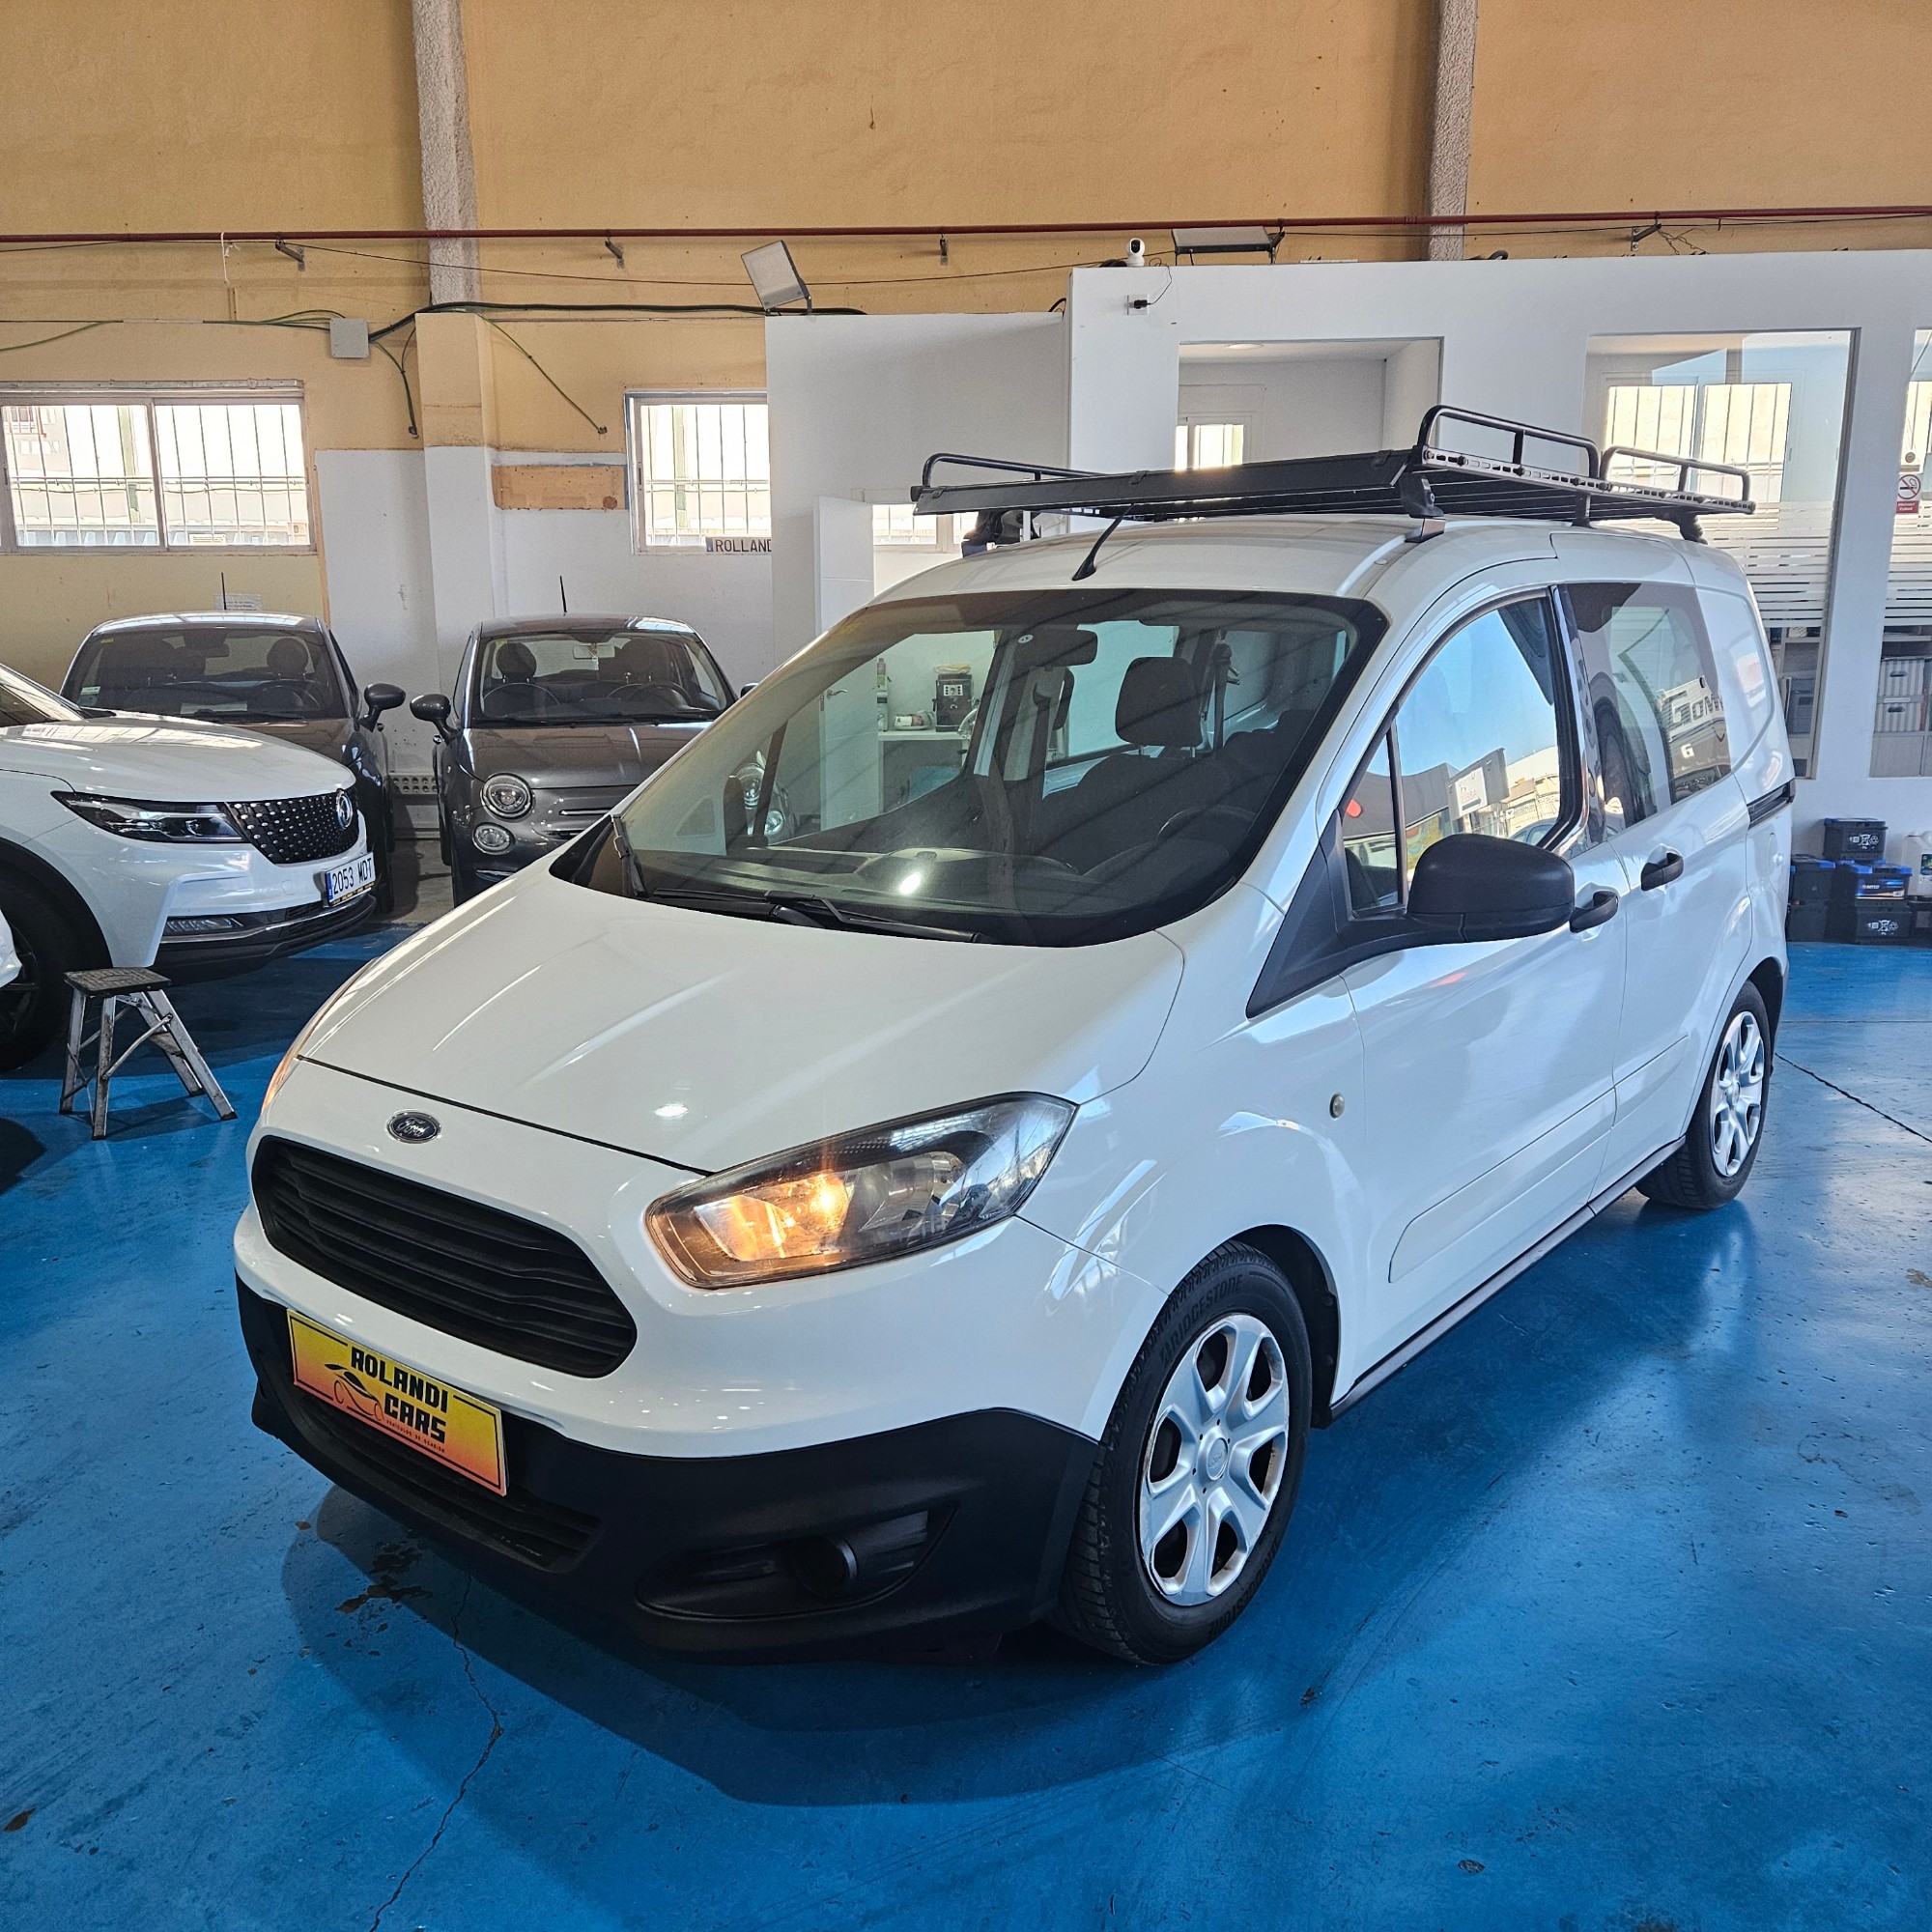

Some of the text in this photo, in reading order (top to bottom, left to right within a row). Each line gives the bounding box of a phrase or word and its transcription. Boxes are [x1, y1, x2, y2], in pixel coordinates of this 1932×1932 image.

[331, 867, 355, 895] 2053
[357, 858, 372, 883] MDT
[351, 1347, 449, 1413] ROLANDI
[384, 1392, 447, 1444] CARS
